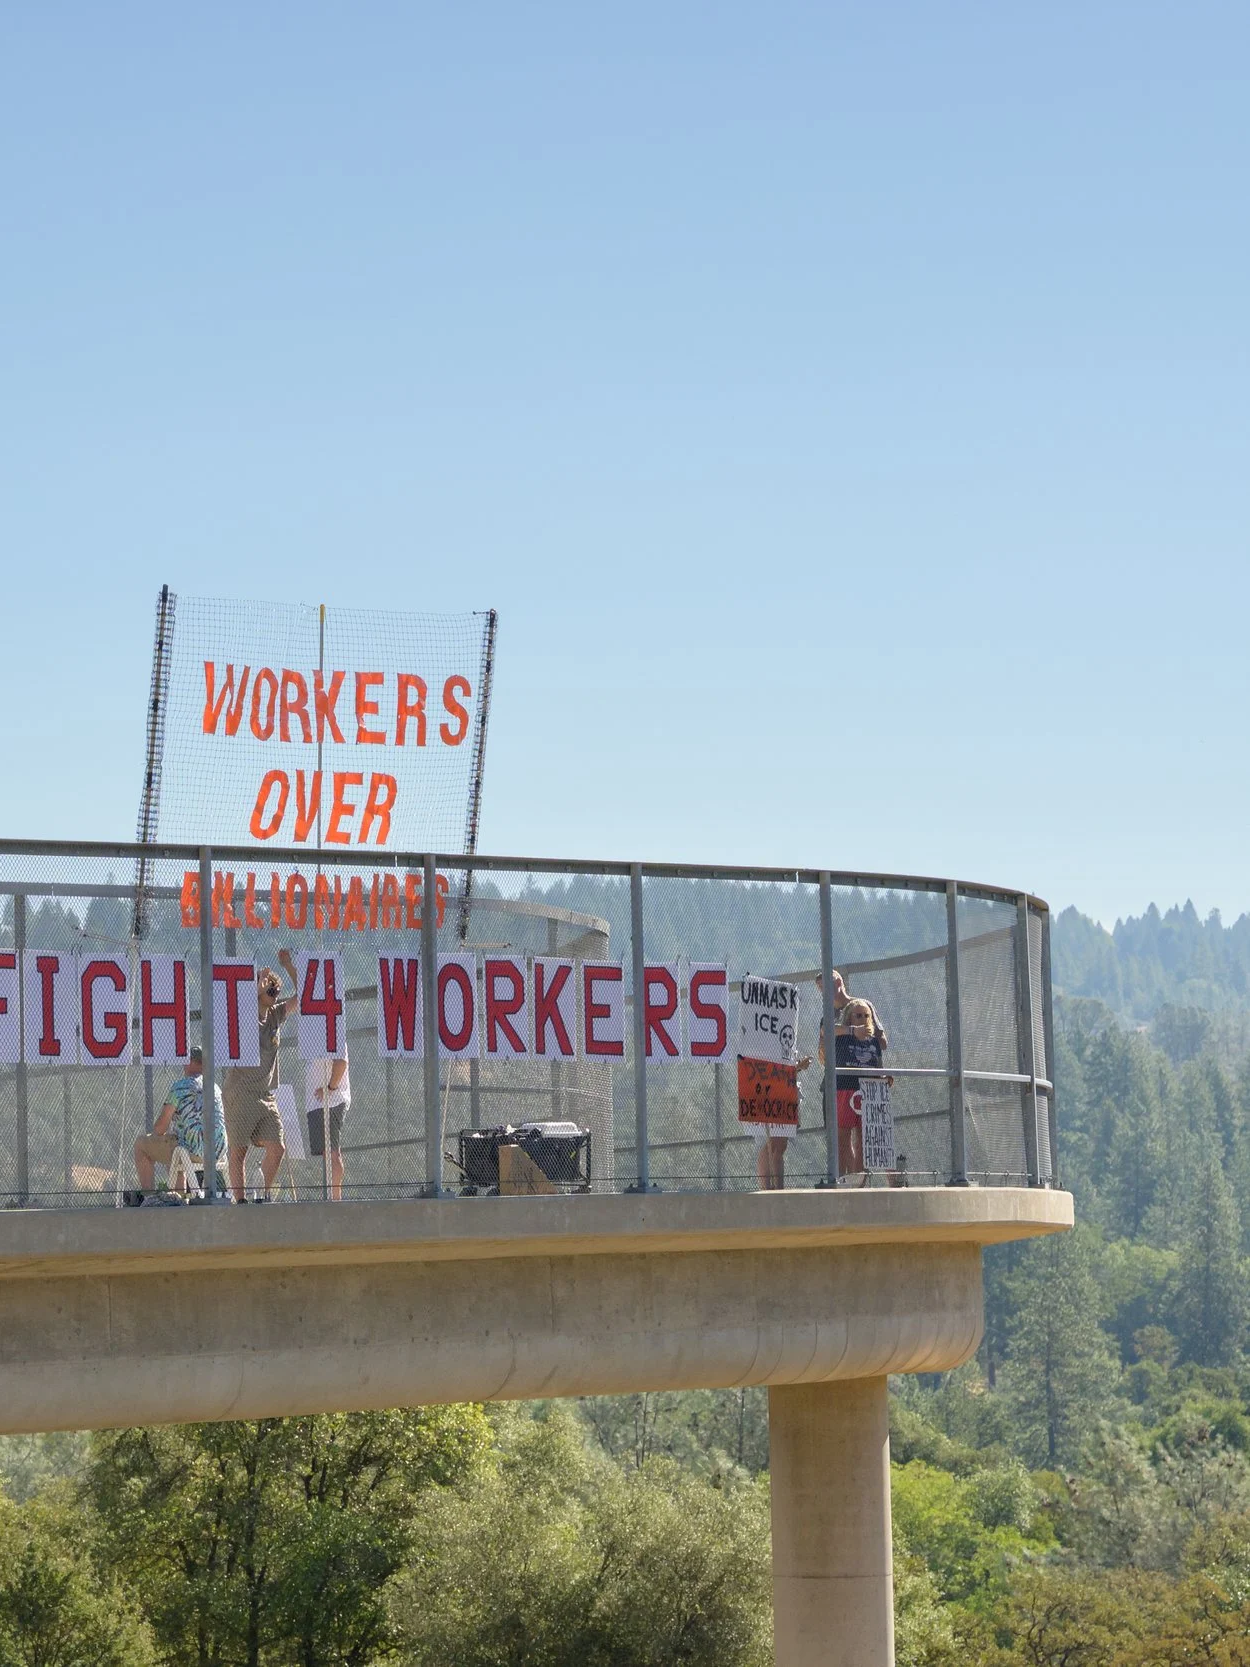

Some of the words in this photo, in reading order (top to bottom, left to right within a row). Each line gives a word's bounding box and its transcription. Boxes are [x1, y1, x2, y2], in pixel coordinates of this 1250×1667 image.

[202, 660, 472, 747] WORKERS
[249, 768, 398, 845] OVER
[180, 870, 449, 931] BILLIONAIRES
[300, 958, 343, 1054] 4
[379, 957, 727, 1057] WORKERS
[740, 980, 798, 1011] UNMASK
[754, 1012, 779, 1035] ICE
